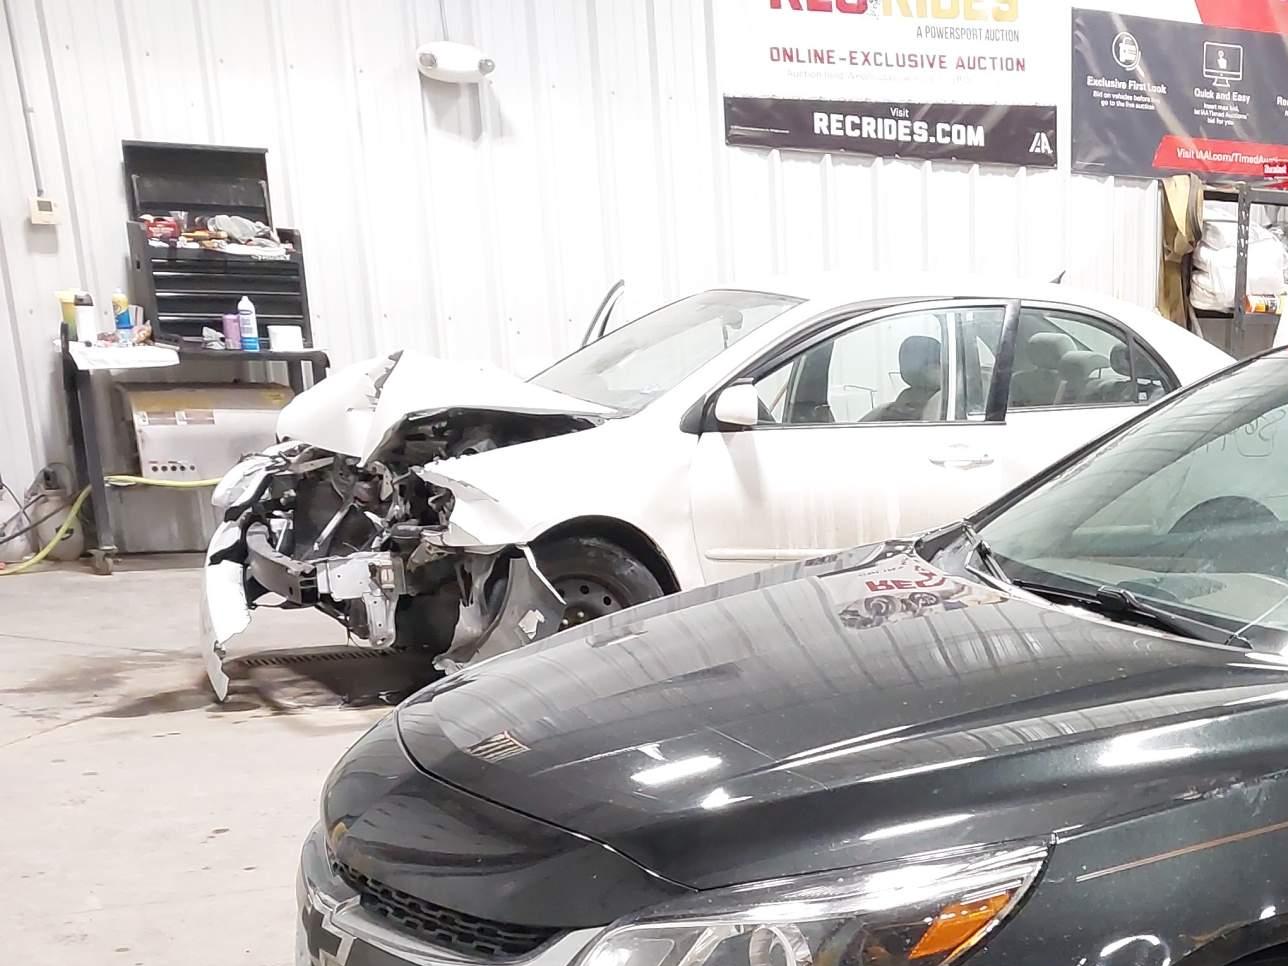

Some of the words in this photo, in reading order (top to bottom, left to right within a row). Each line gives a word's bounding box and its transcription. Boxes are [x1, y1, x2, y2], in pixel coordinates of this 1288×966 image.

[916, 26, 923, 39] A
[925, 25, 983, 41] POWERSPORT
[985, 28, 1020, 43] AUCTION
[769, 46, 948, 70] ONLINE-EXCLUSIVE
[955, 55, 1026, 73] AUCTION
[1087, 76, 1127, 90] Exclusive
[1128, 80, 1146, 91] First
[1147, 83, 1168, 94] Look
[1194, 88, 1214, 99] Quick
[1215, 91, 1231, 101] and
[1232, 91, 1251, 104] Easy
[890, 107, 910, 118] Visit
[813, 112, 986, 147] RECRIDES.COM
[1177, 148, 1198, 159] Visit
